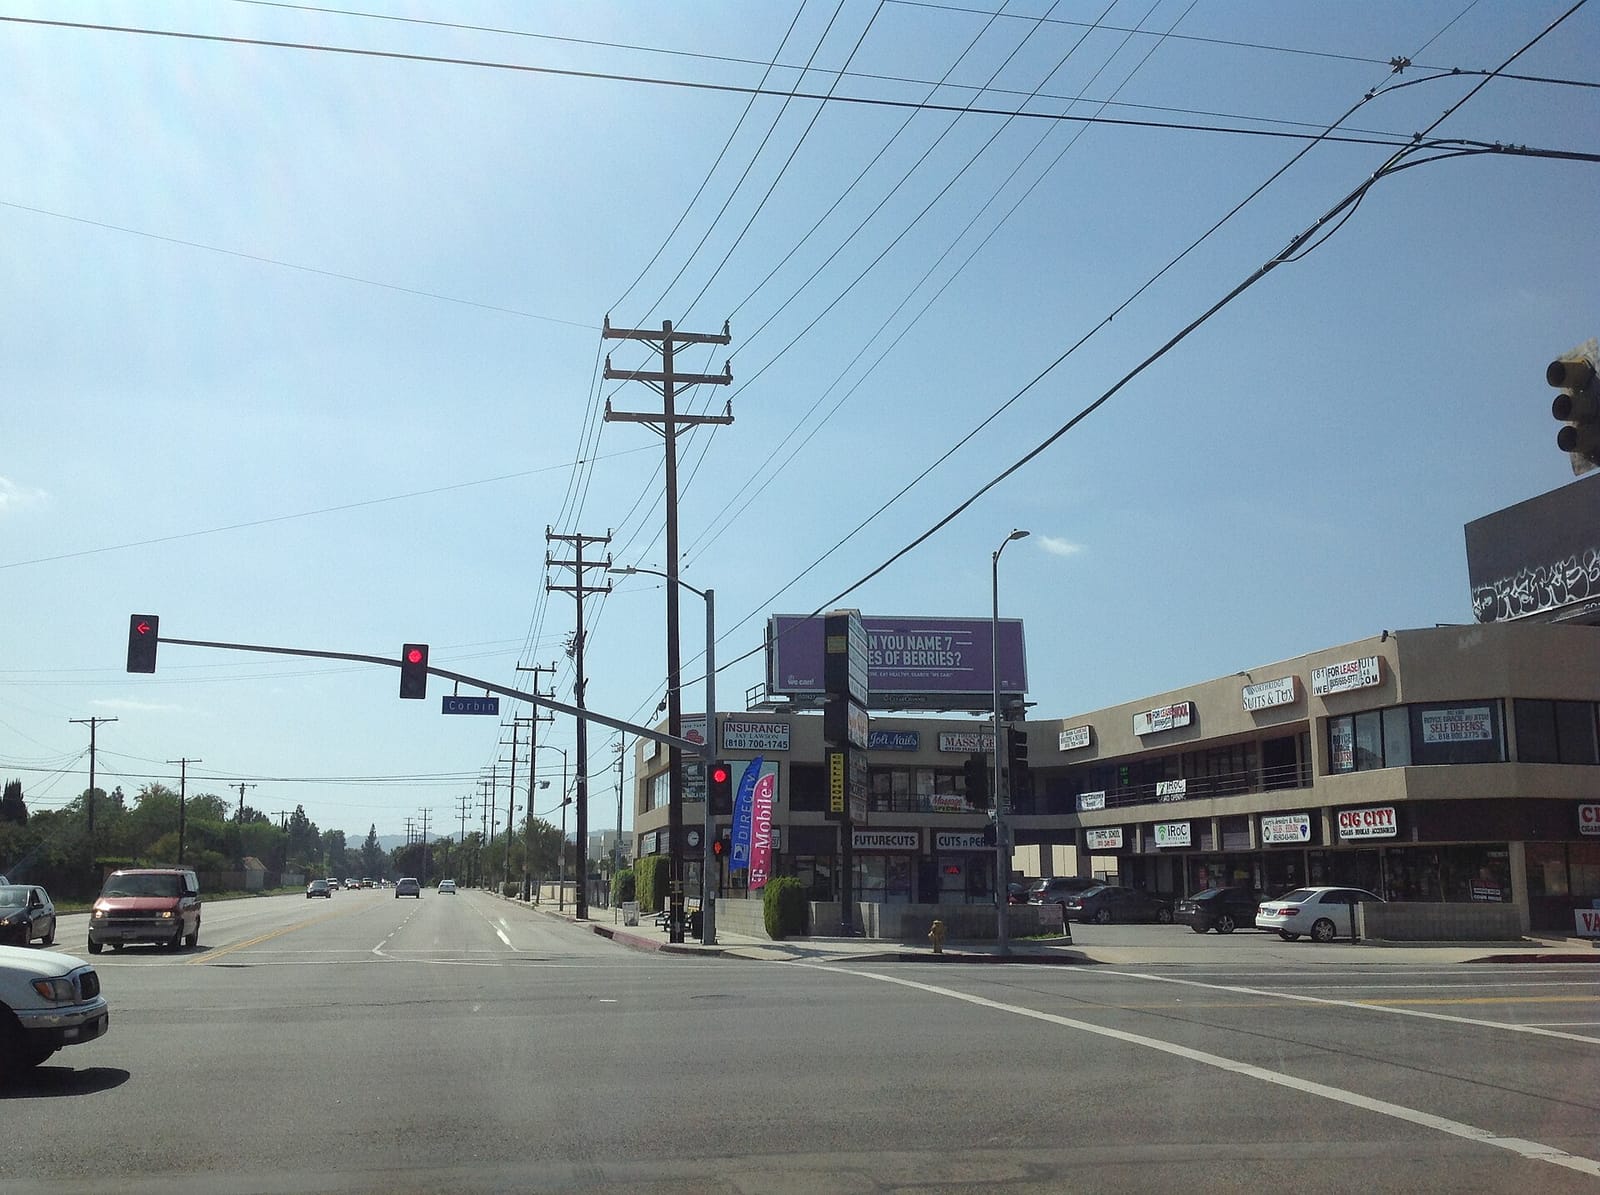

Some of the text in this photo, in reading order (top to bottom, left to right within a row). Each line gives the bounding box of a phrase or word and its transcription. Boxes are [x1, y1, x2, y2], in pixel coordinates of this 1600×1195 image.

[880, 635, 905, 650] YOU
[907, 636, 942, 651] NAME
[944, 636, 953, 651] 7
[885, 650, 900, 666] OF
[903, 651, 962, 666] BERRIES?
[1327, 666, 1340, 678] FOR
[1340, 661, 1358, 675] LEASE
[449, 701, 495, 711] Corbin
[1242, 695, 1266, 710] SUITS
[1268, 691, 1274, 705] &
[725, 723, 789, 735] INSURANCE
[1430, 721, 1485, 733] SELF DEFENSE
[725, 739, 788, 749] (818) 700-1745
[890, 732, 917, 746] Nails
[738, 774, 757, 840] DIRECTV
[1581, 806, 1600, 823] CI
[1340, 809, 1394, 828] CIG CITY
[854, 835, 916, 846] FUTURECUTS
[938, 836, 961, 847] CUTS
